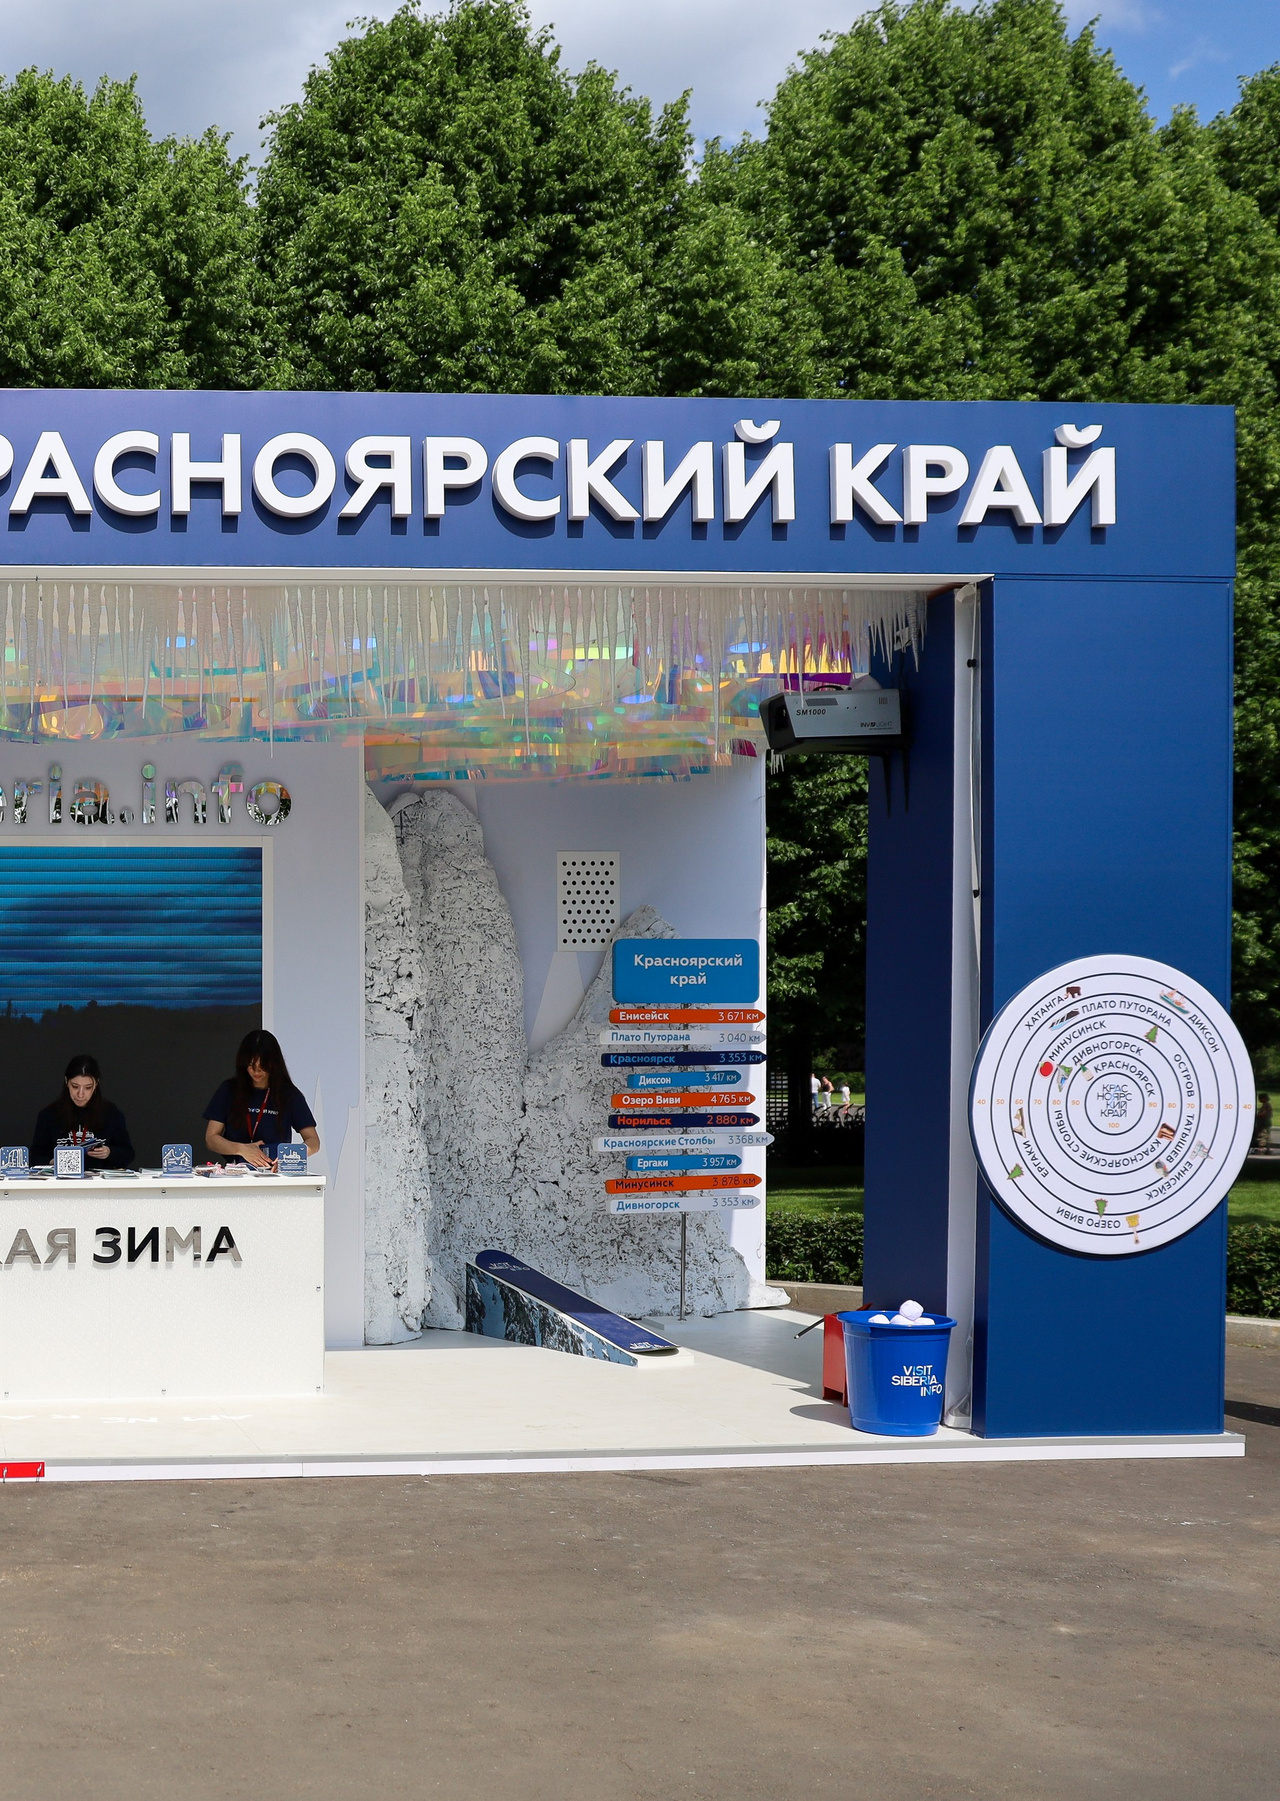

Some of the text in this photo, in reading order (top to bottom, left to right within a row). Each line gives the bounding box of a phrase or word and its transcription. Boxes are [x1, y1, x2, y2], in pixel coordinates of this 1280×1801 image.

[829, 425, 1119, 531] КРАЙ
[796, 708, 827, 716] SM1000
[633, 954, 743, 967] Красноярский
[670, 973, 707, 986] край
[619, 1010, 670, 1021] Енисейск
[1024, 995, 1065, 1031] ХАТАНГА
[1081, 999, 1172, 1027] ПЛАТО ПУТОРАНА
[611, 1032, 641, 1042] Плато
[644, 1032, 690, 1043] Путорана
[1188, 1013, 1220, 1054] ДИКСОН
[1048, 1020, 1107, 1062] МИНУСИНСК
[610, 1054, 675, 1065] Красноярск
[1071, 1040, 1144, 1066] ДИВНОГОРСК
[638, 1075, 671, 1086] Диксон
[1093, 1060, 1156, 1097] КРАСНОЯРСК
[1102, 1084, 1129, 1093] КРАС
[622, 1095, 654, 1106] Озеро
[656, 1095, 681, 1104] Виви
[1100, 1109, 1128, 1117] КРАЙ
[1166, 1053, 1195, 1163] ОСТРОВ ТАТЫШЕВ
[617, 1116, 672, 1127] Норильск
[603, 1138, 676, 1149] Красноярские
[678, 1136, 716, 1146] Столбы
[1054, 1110, 1162, 1168] КРАСНОЯРСКИЕ СТОЛБЫ
[637, 1159, 669, 1169] Ергаки
[1023, 1140, 1050, 1178] ЕРГАКИ
[615, 1180, 674, 1191] Минусинск
[1145, 1161, 1194, 1201] ЕНИСЕЙСК
[616, 1200, 680, 1212] Дивногорск
[1056, 1206, 1121, 1229] ОЗЕРО ВИВИ
[91, 1225, 243, 1264] ЗИМА
[903, 1365, 933, 1376] VISIT
[920, 1384, 943, 1397] INFO
